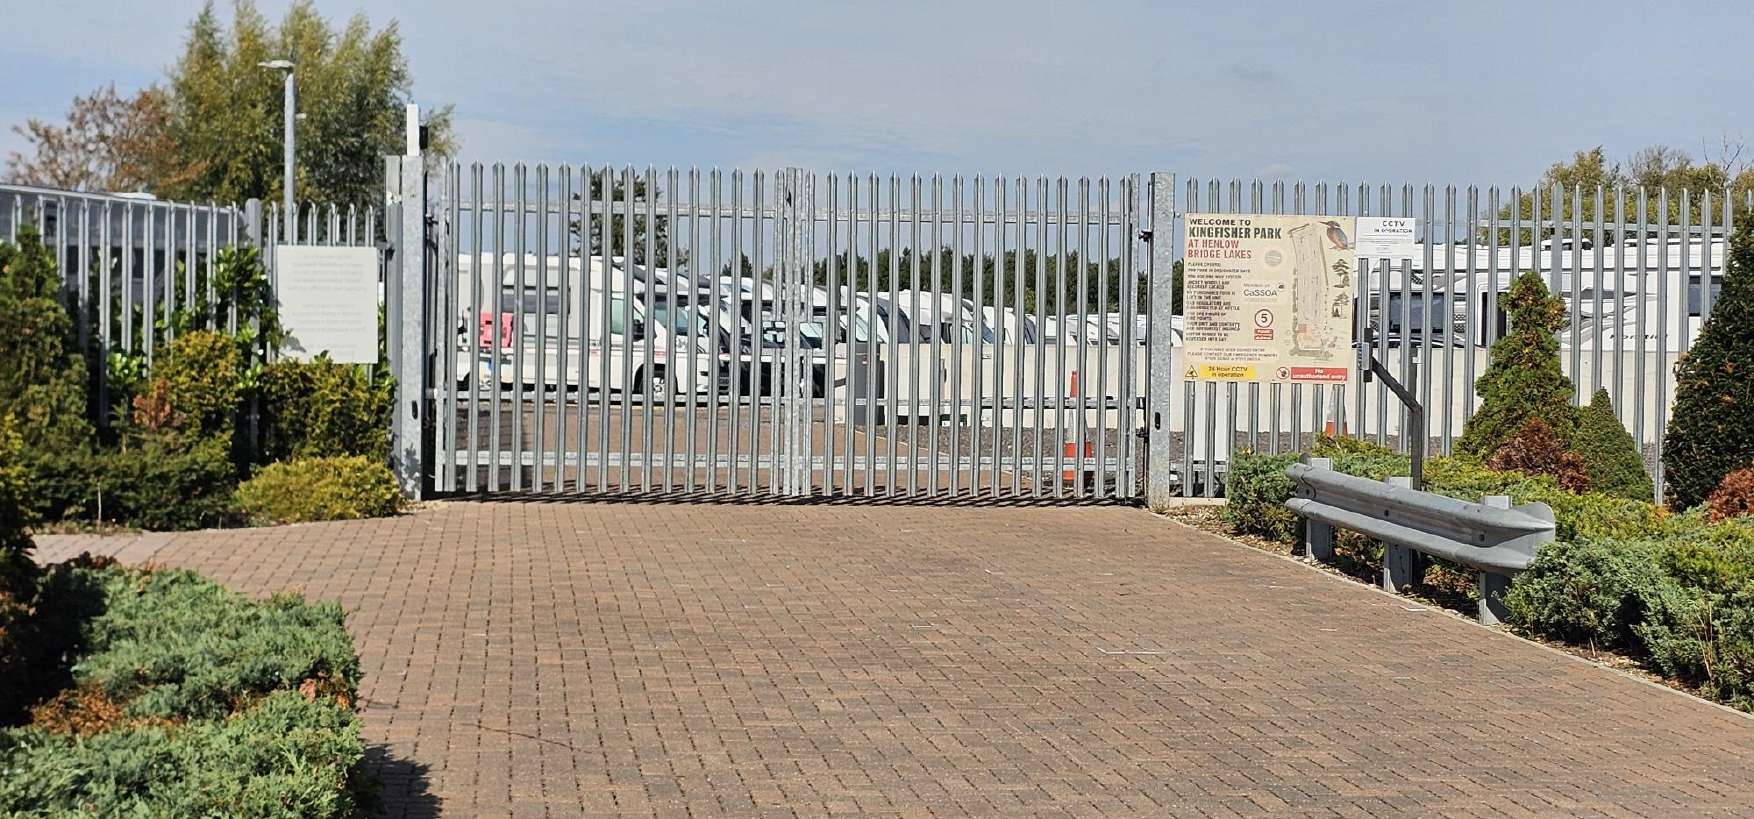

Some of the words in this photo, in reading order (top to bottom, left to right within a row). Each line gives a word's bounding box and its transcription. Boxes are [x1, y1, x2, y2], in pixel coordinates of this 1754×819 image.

[1189, 218, 1236, 226] WELCOME
[1189, 226, 1251, 238] KINGFISHER
[1254, 228, 1282, 239] PARK
[1188, 239, 1198, 248] AT
[1202, 240, 1240, 248] HENLOW
[1188, 249, 1221, 258] BRIDGE
[1224, 250, 1252, 259] LAKES
[1261, 314, 1268, 323] 5
